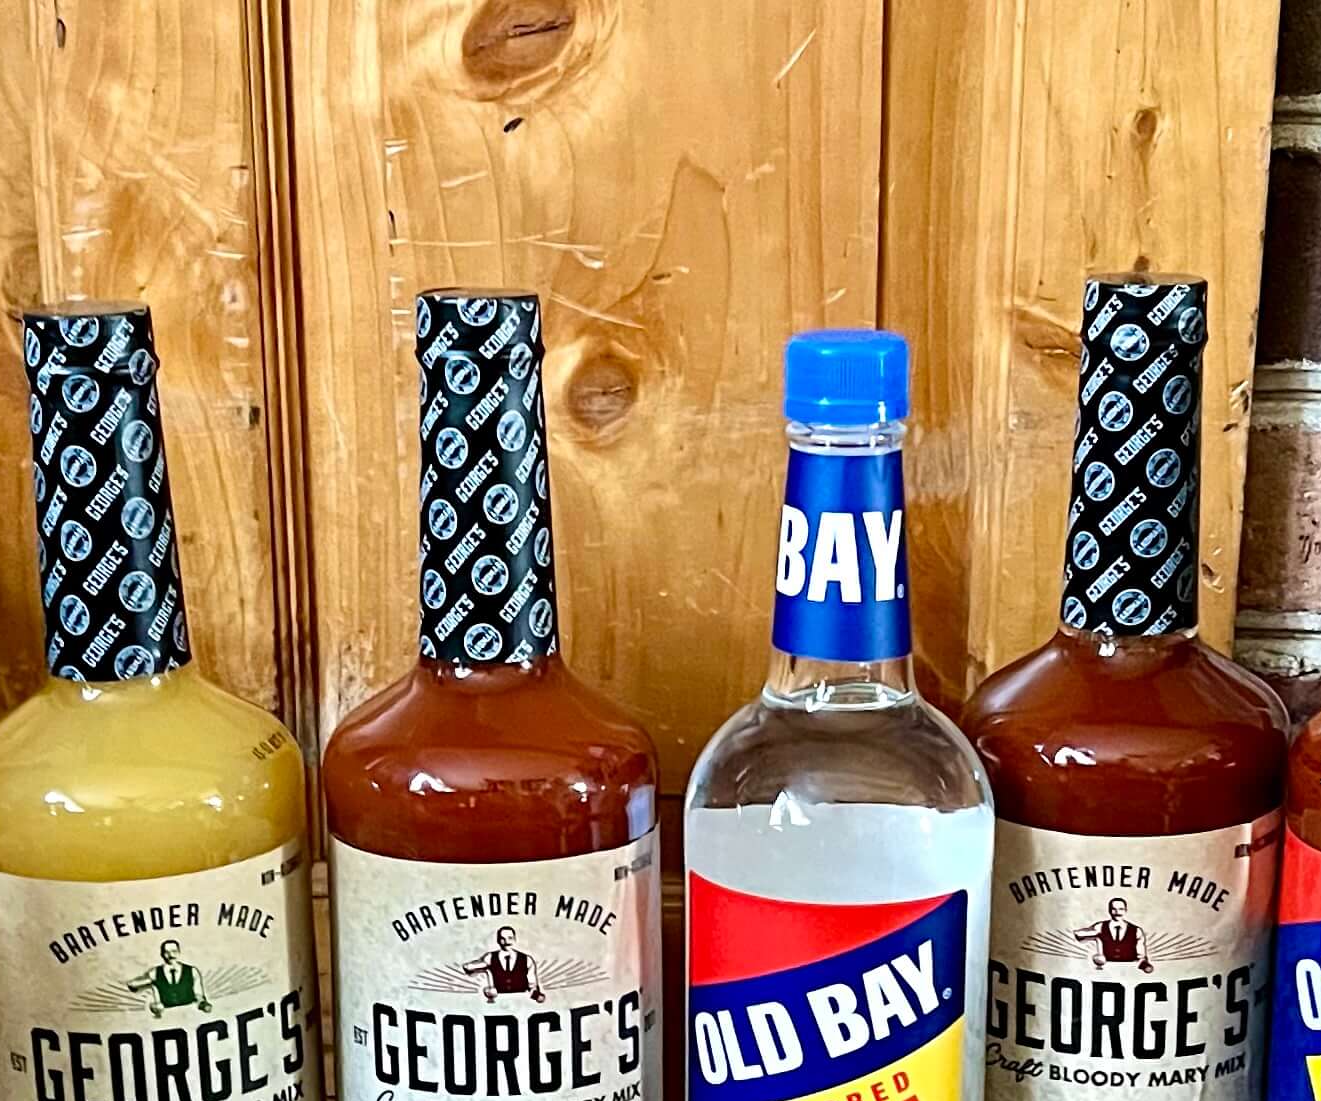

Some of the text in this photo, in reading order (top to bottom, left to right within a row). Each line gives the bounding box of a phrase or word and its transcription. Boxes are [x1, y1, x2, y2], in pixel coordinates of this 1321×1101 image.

[465, 376, 511, 432] GEORGE'S
[1114, 413, 1164, 466] GEORGE'S
[455, 449, 500, 504] GEORGE'S
[1098, 486, 1148, 537] GEORGE'S
[82, 539, 129, 597] GEORGE'S
[776, 504, 903, 603] BAY
[1009, 865, 1230, 912] BARTENDER MADE
[49, 903, 275, 965] BARTENDER MADE
[391, 892, 618, 943] BARTENDER MADE
[694, 940, 941, 1086] OLD BAY
[986, 959, 1250, 1060] GEORGE'S
[353, 990, 640, 1098] EST GEORGE'S
[986, 1042, 1247, 1088] Craft BLOODY MARY MIX
